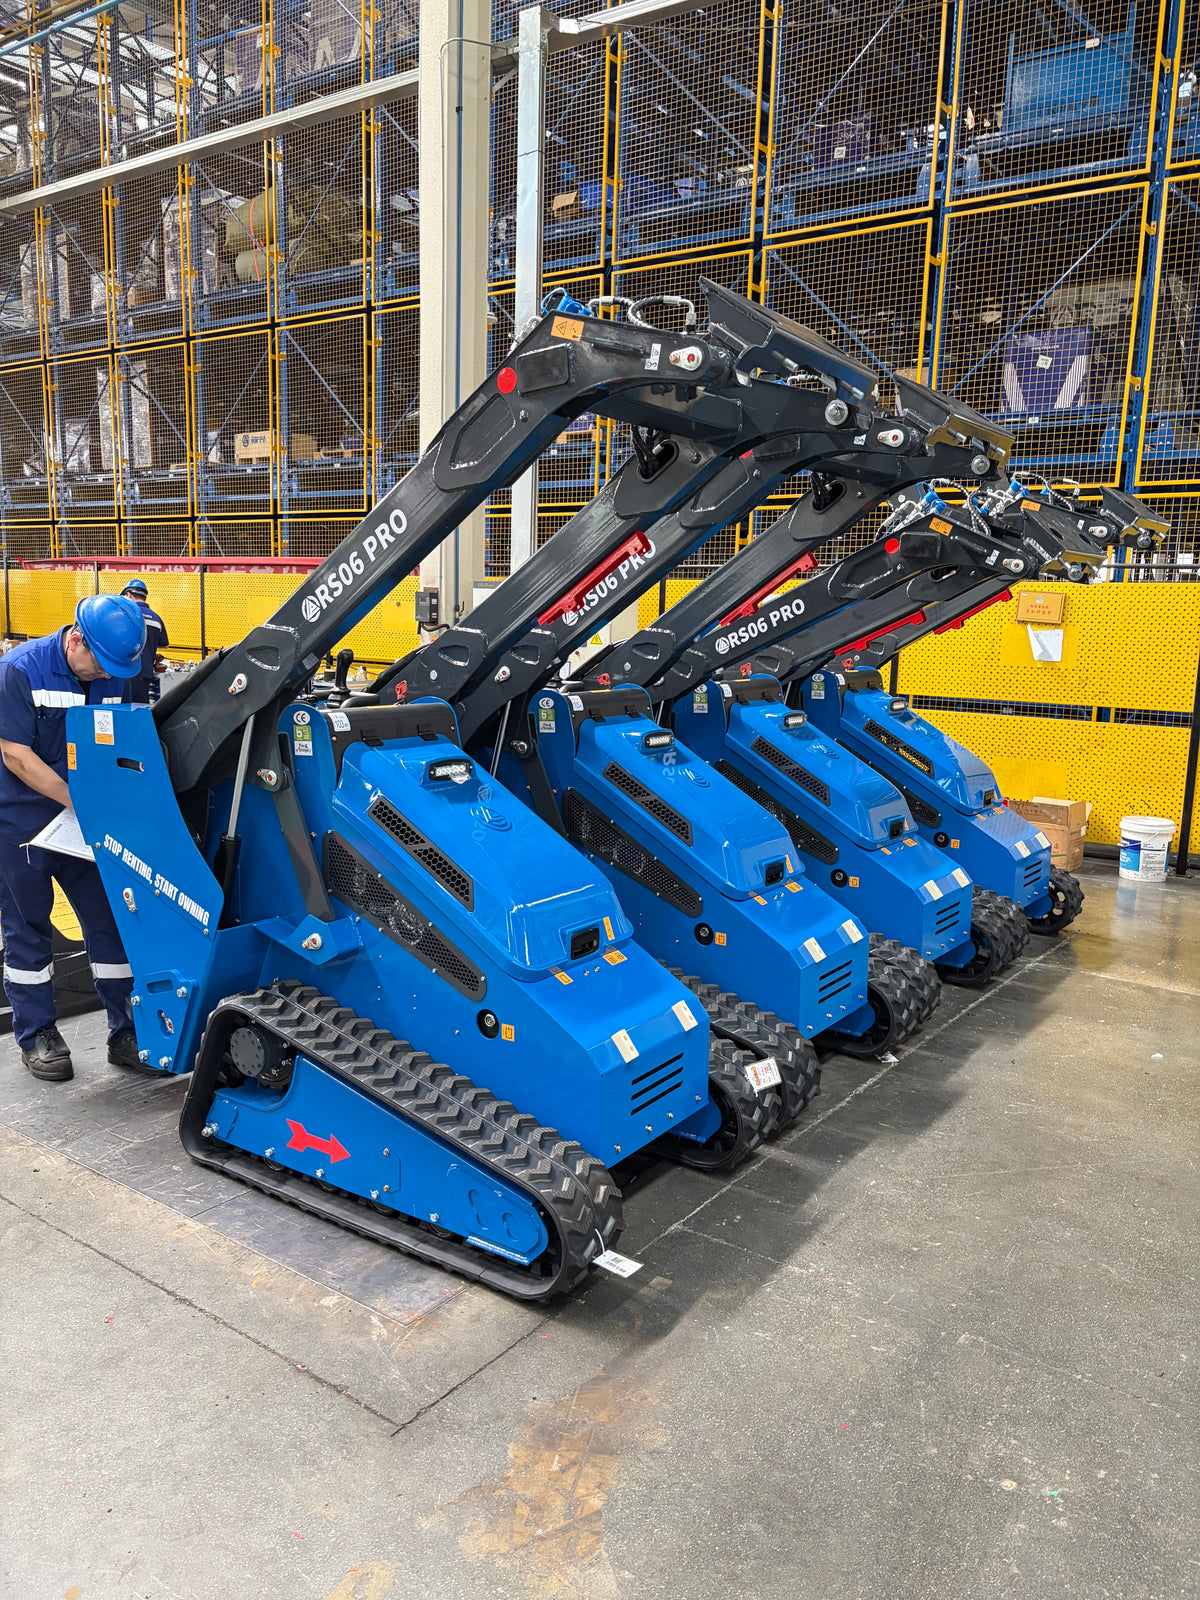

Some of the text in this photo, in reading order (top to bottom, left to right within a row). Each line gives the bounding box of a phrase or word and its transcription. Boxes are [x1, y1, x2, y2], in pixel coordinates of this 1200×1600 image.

[315, 509, 407, 610] RS06 PRO
[727, 599, 805, 649] RS06 PRO
[103, 834, 209, 926] STOP RENTING, START OWNING
